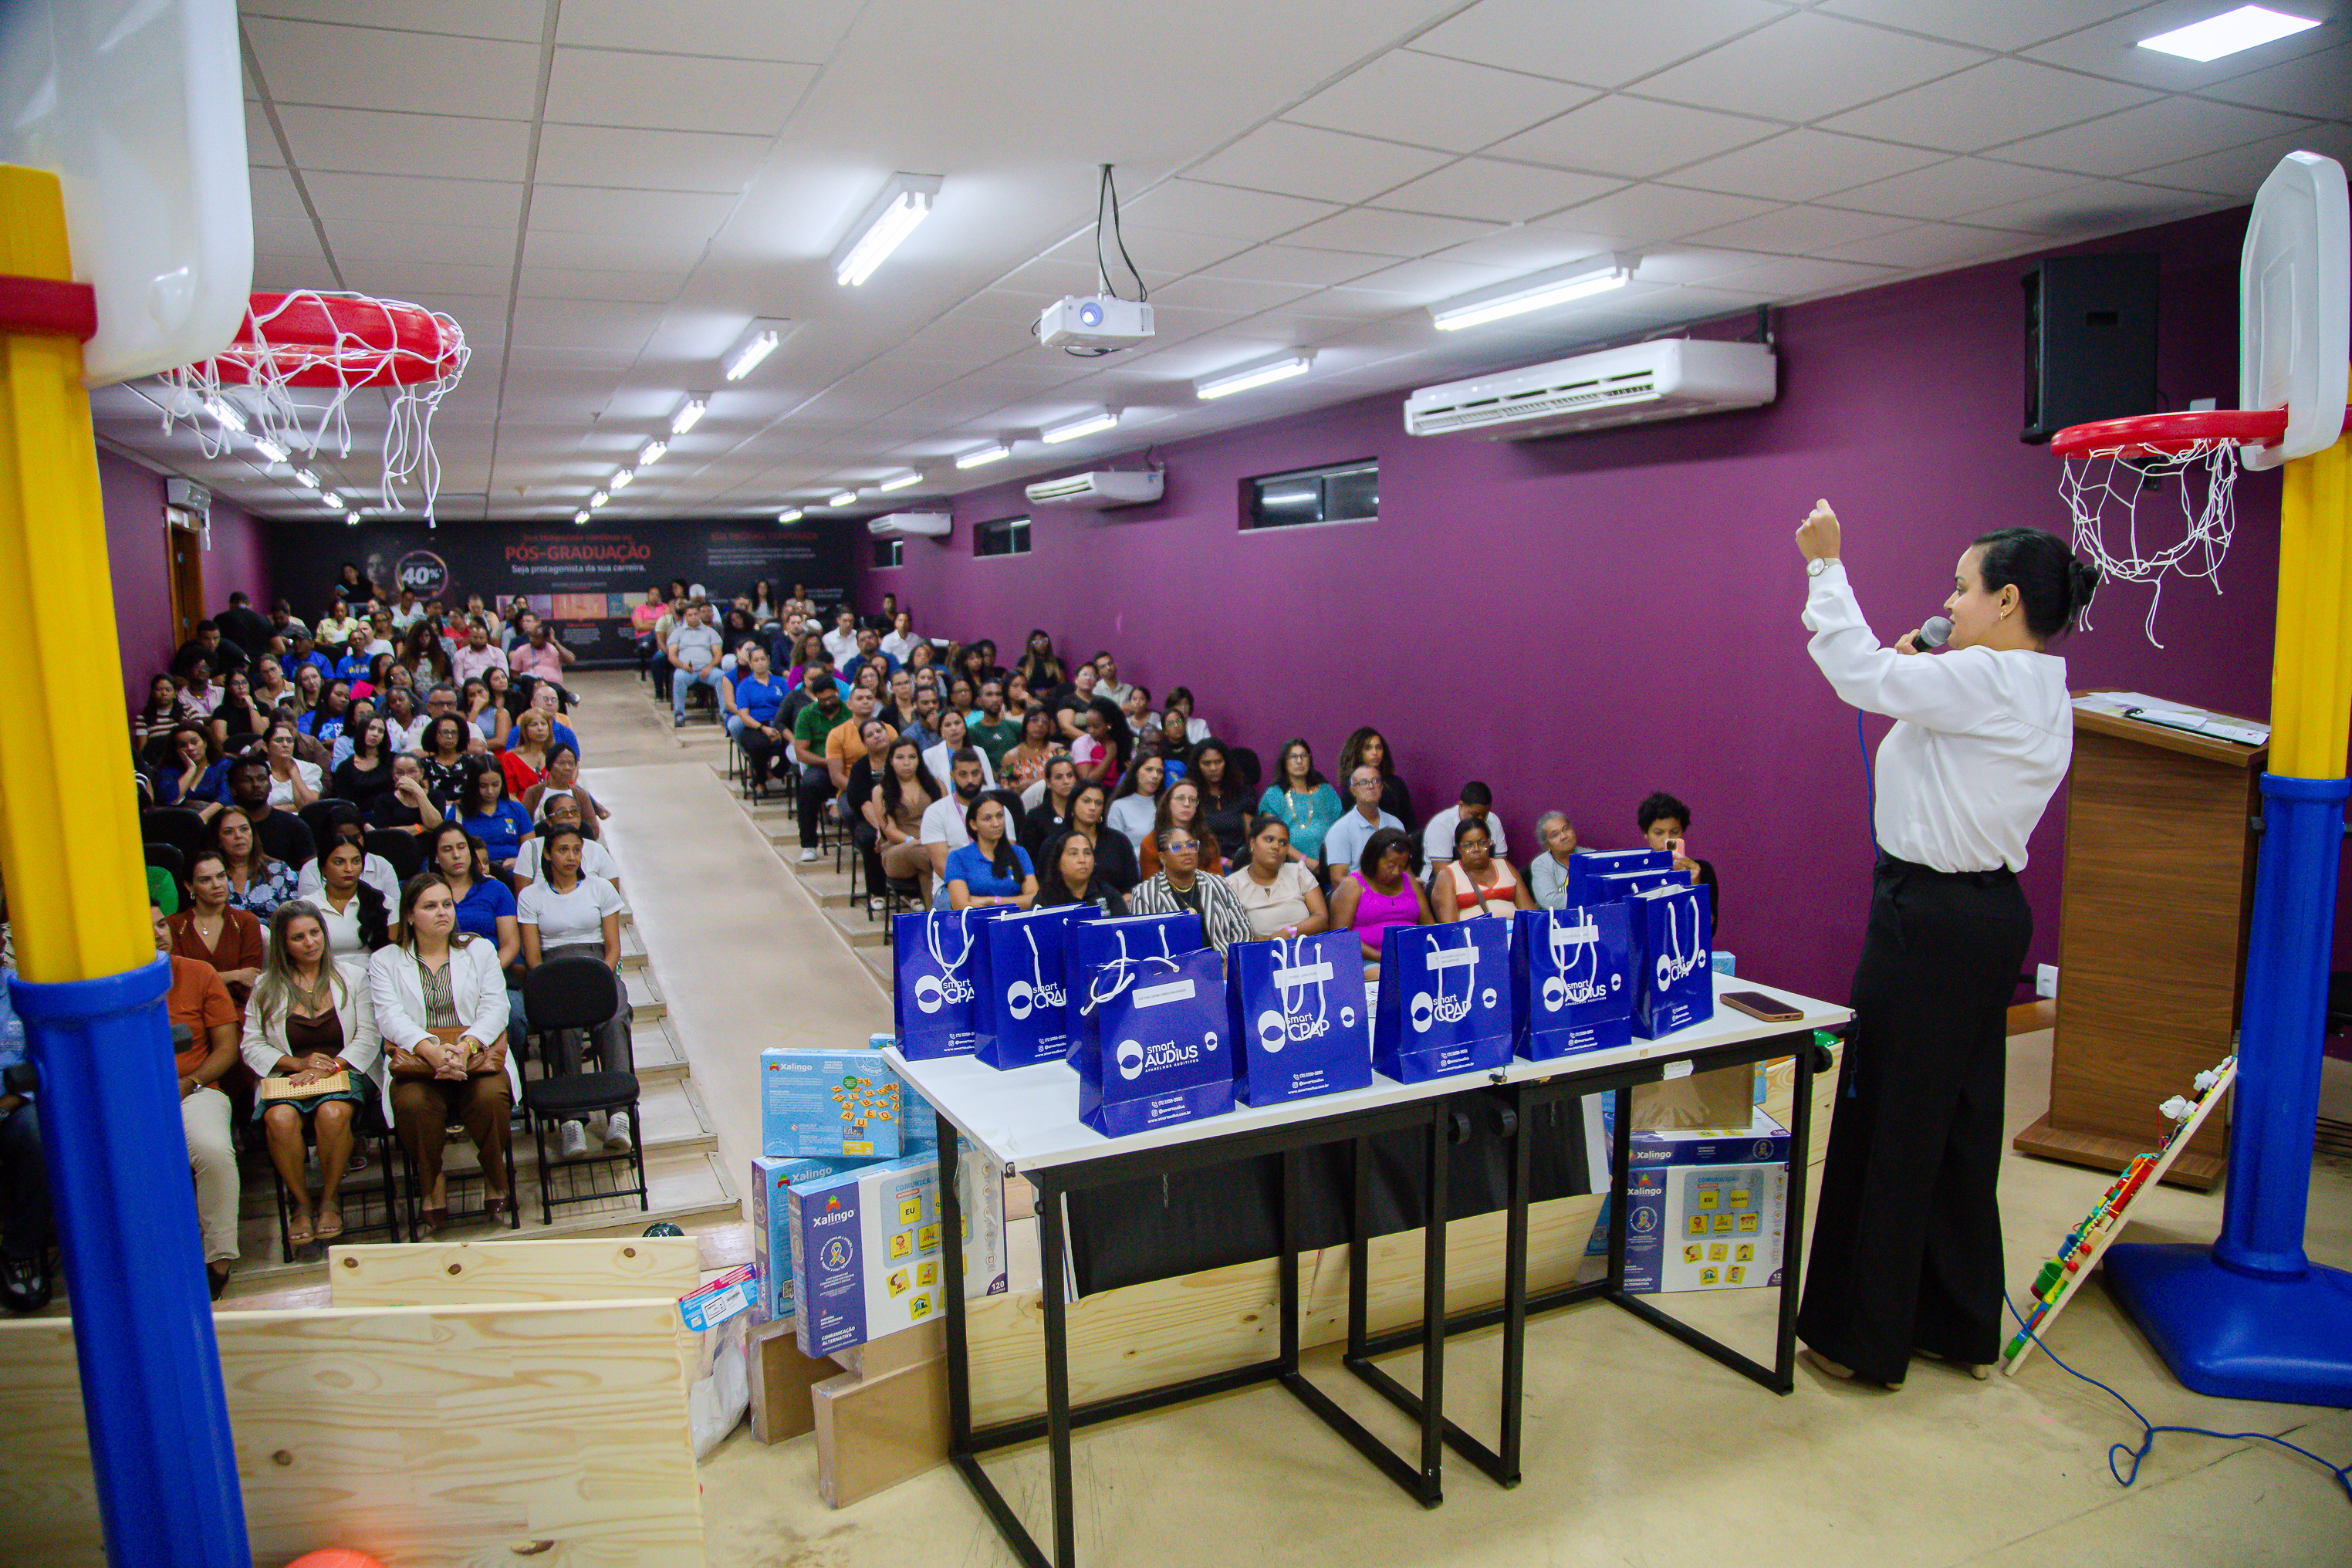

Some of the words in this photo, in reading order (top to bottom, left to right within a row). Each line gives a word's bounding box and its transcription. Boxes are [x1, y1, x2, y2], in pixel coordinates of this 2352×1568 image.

[505, 542, 651, 563] PÓS-GRADUAÇÃO
[512, 565, 529, 575] Seja
[531, 565, 583, 575] protagonista
[613, 564, 646, 573] carreira.
[943, 978, 971, 989] smart
[1567, 979, 1590, 989] smart
[1287, 1012, 1313, 1024] smart
[1289, 1019, 1330, 1039] CPAP
[1147, 1040, 1175, 1054] smart
[781, 1063, 813, 1072] Xalingo
[1174, 1059, 1199, 1067] AUDITIVOS
[860, 1064, 882, 1074] Xalingo
[1637, 1151, 1672, 1160] Xalingo
[792, 1166, 833, 1184] Xalingo
[1627, 1188, 1662, 1196] Xalingo
[905, 1207, 915, 1215] EU
[813, 1209, 854, 1227] Xalingo
[992, 1280, 1005, 1291] 120
[822, 1326, 856, 1341] COMUNICAÇÃO
[822, 1332, 853, 1346] ALTERNATIVA
